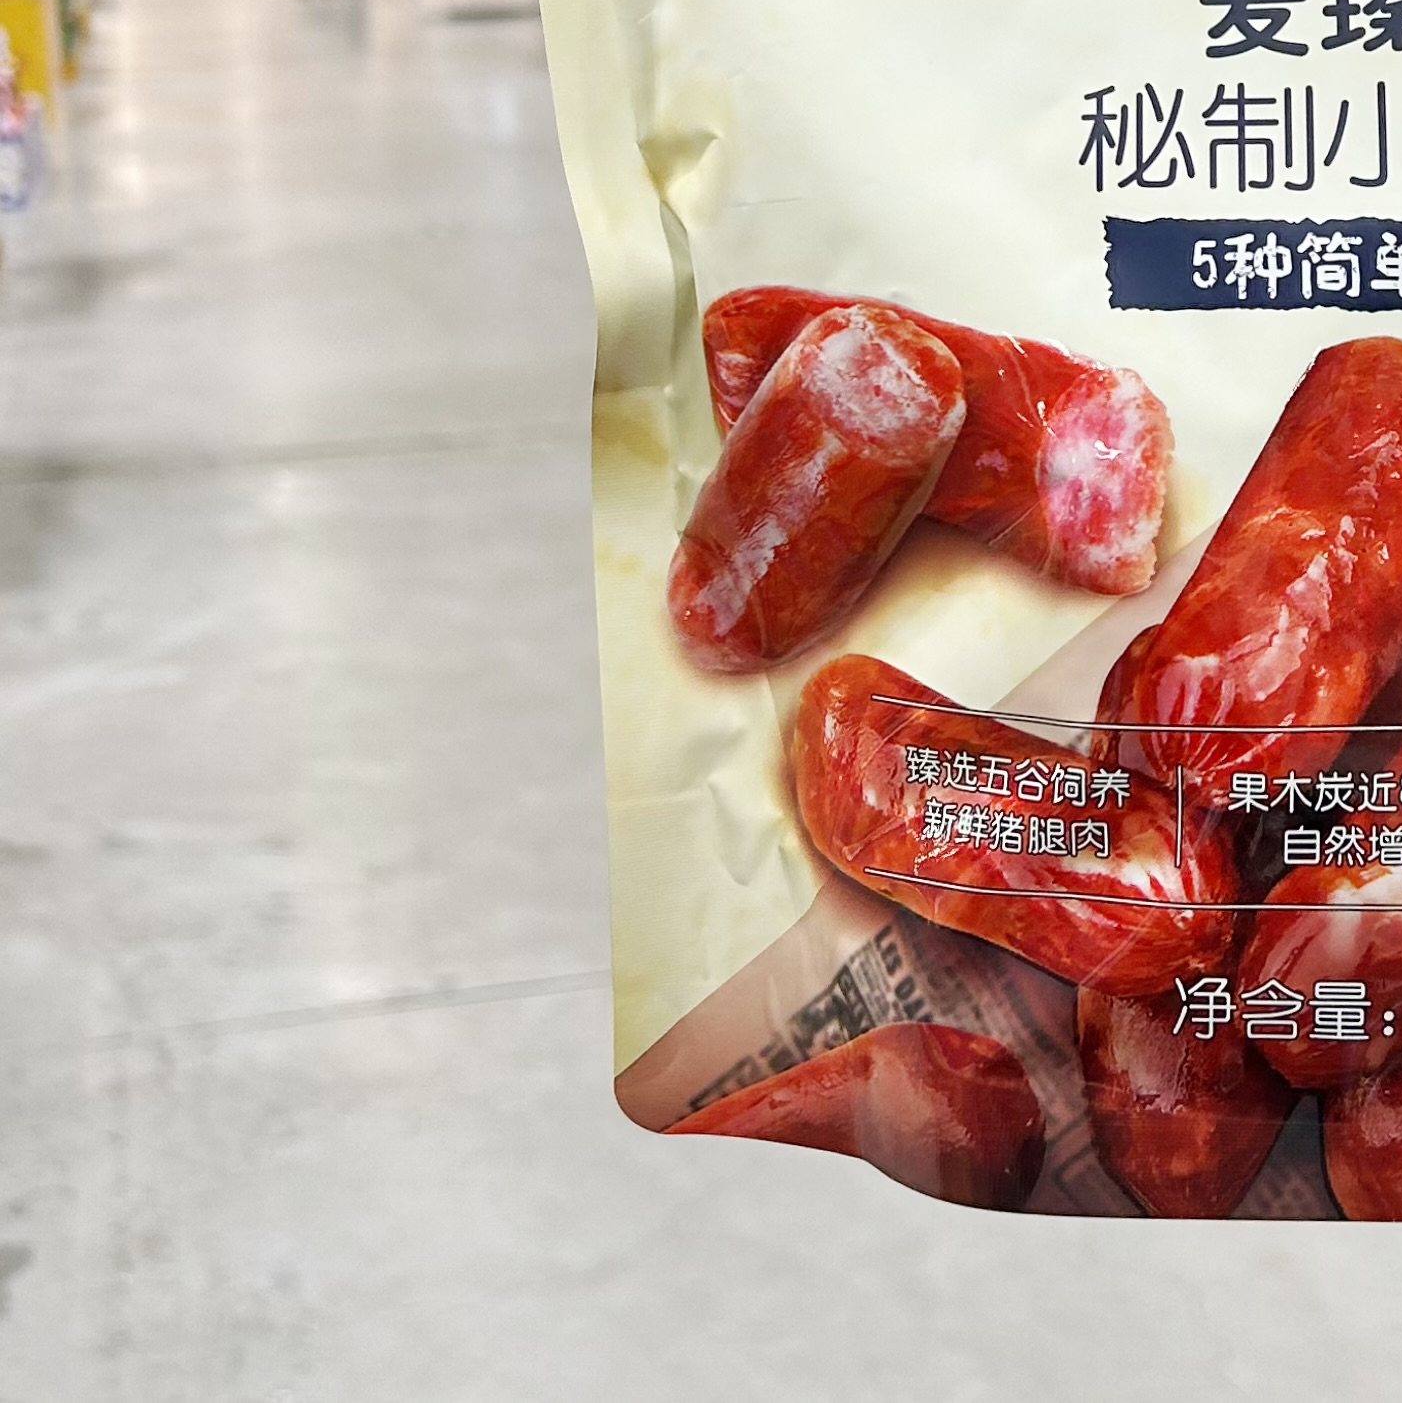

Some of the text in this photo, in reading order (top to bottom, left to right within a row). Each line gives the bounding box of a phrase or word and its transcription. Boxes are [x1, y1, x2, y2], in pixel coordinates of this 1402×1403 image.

[905, 745, 1132, 810] 臻选五谷饲养
[923, 797, 1111, 859] 新鲜猪腿肉
